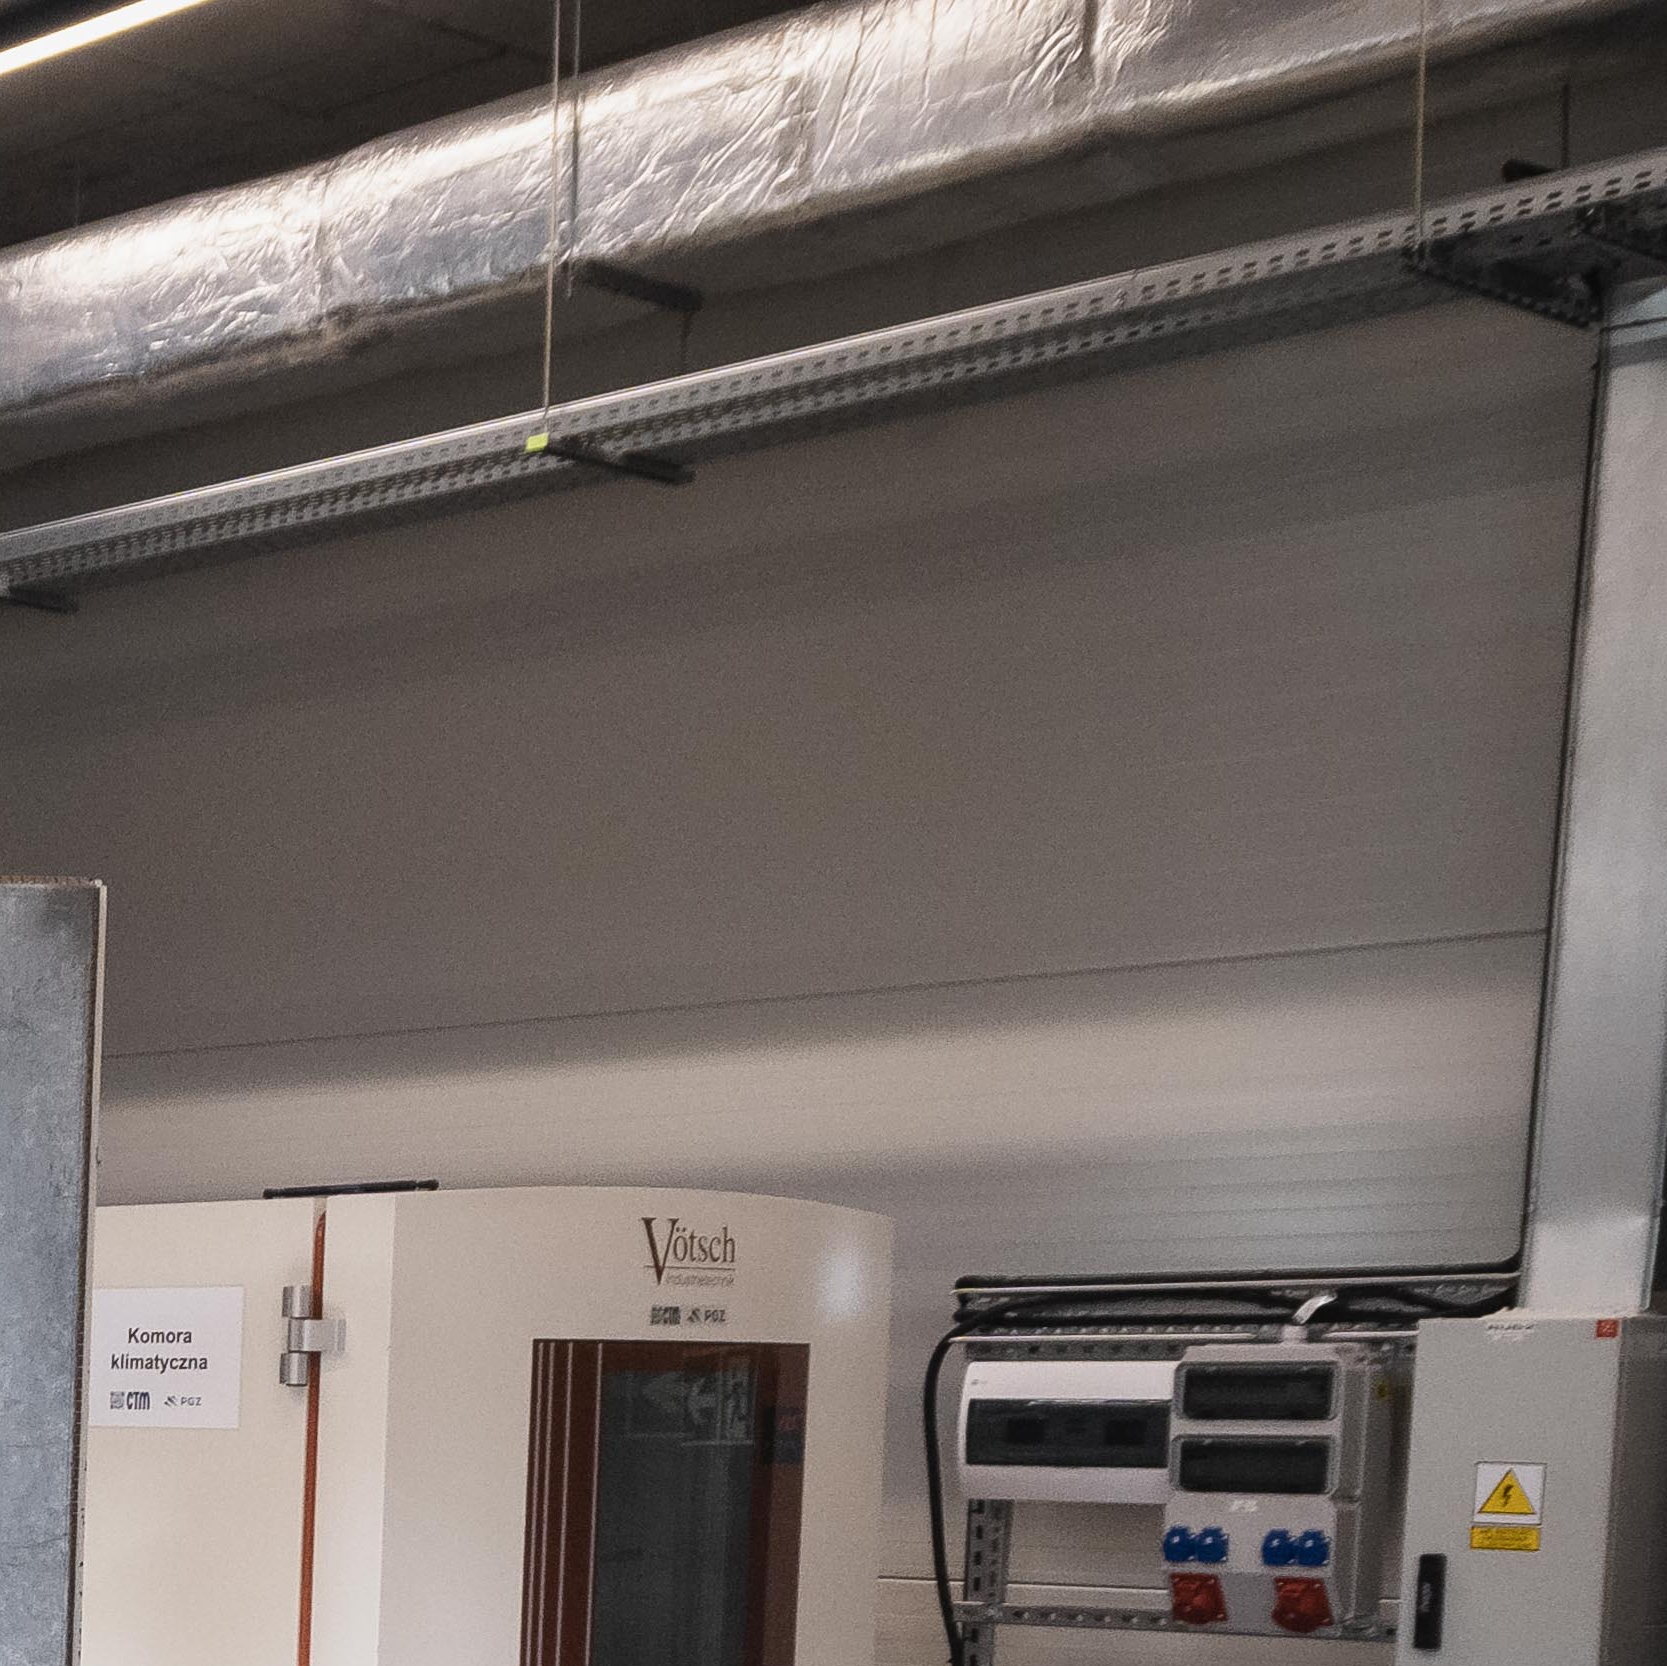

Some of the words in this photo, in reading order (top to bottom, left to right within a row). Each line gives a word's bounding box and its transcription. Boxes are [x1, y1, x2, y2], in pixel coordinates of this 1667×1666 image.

[641, 1217, 736, 1286] Vötsch
[128, 1327, 192, 1344] Komora
[110, 1353, 208, 1374] klimatyczna
[126, 1391, 150, 1410] CTM
[180, 1396, 202, 1407] PGZ
